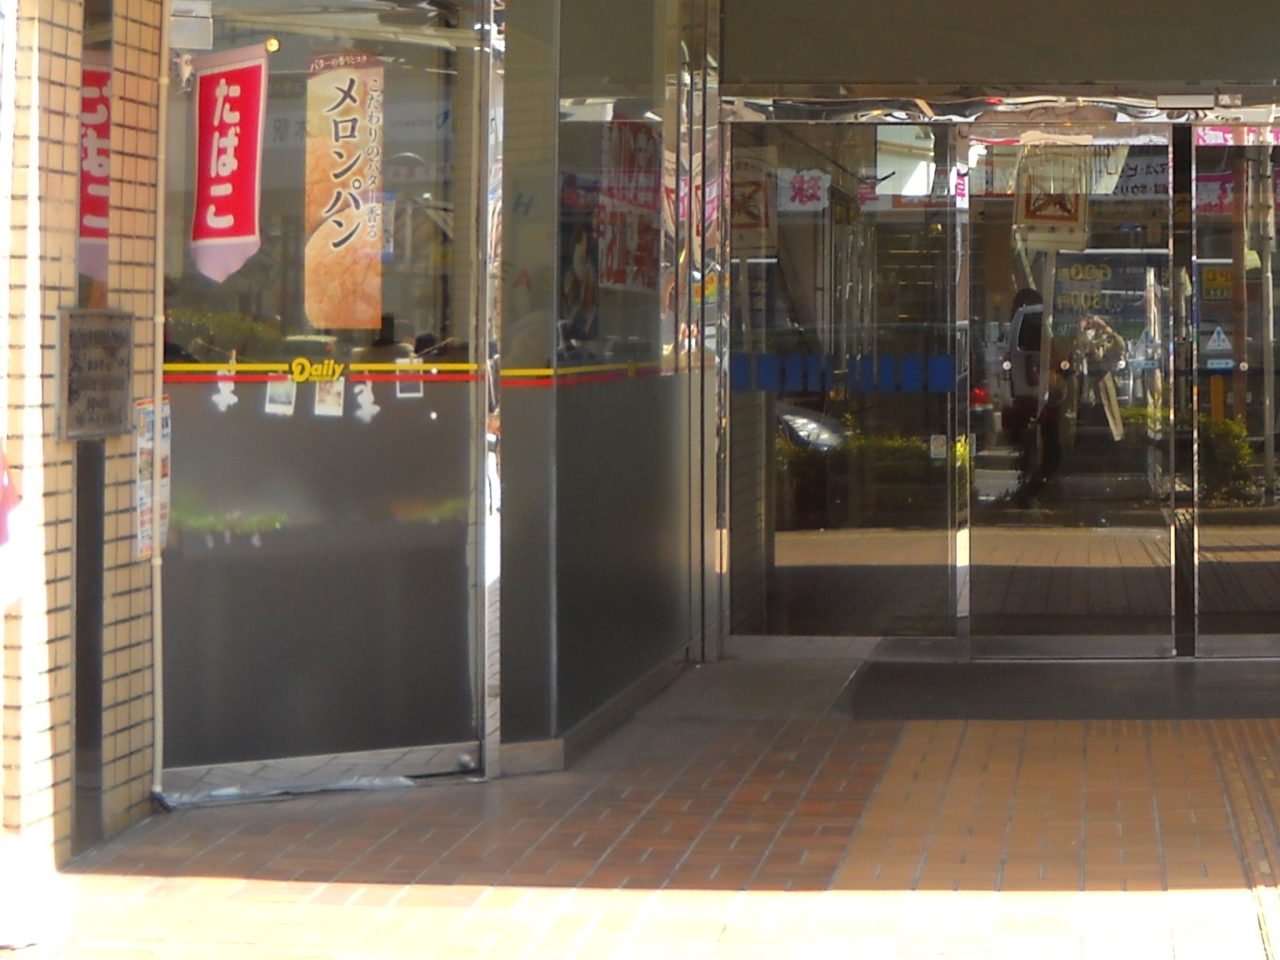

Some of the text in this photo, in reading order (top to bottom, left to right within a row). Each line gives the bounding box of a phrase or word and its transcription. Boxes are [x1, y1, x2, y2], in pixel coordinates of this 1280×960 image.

[205, 77, 241, 230] たばこ
[324, 77, 362, 251] メロンパン
[291, 356, 345, 382] Daily
